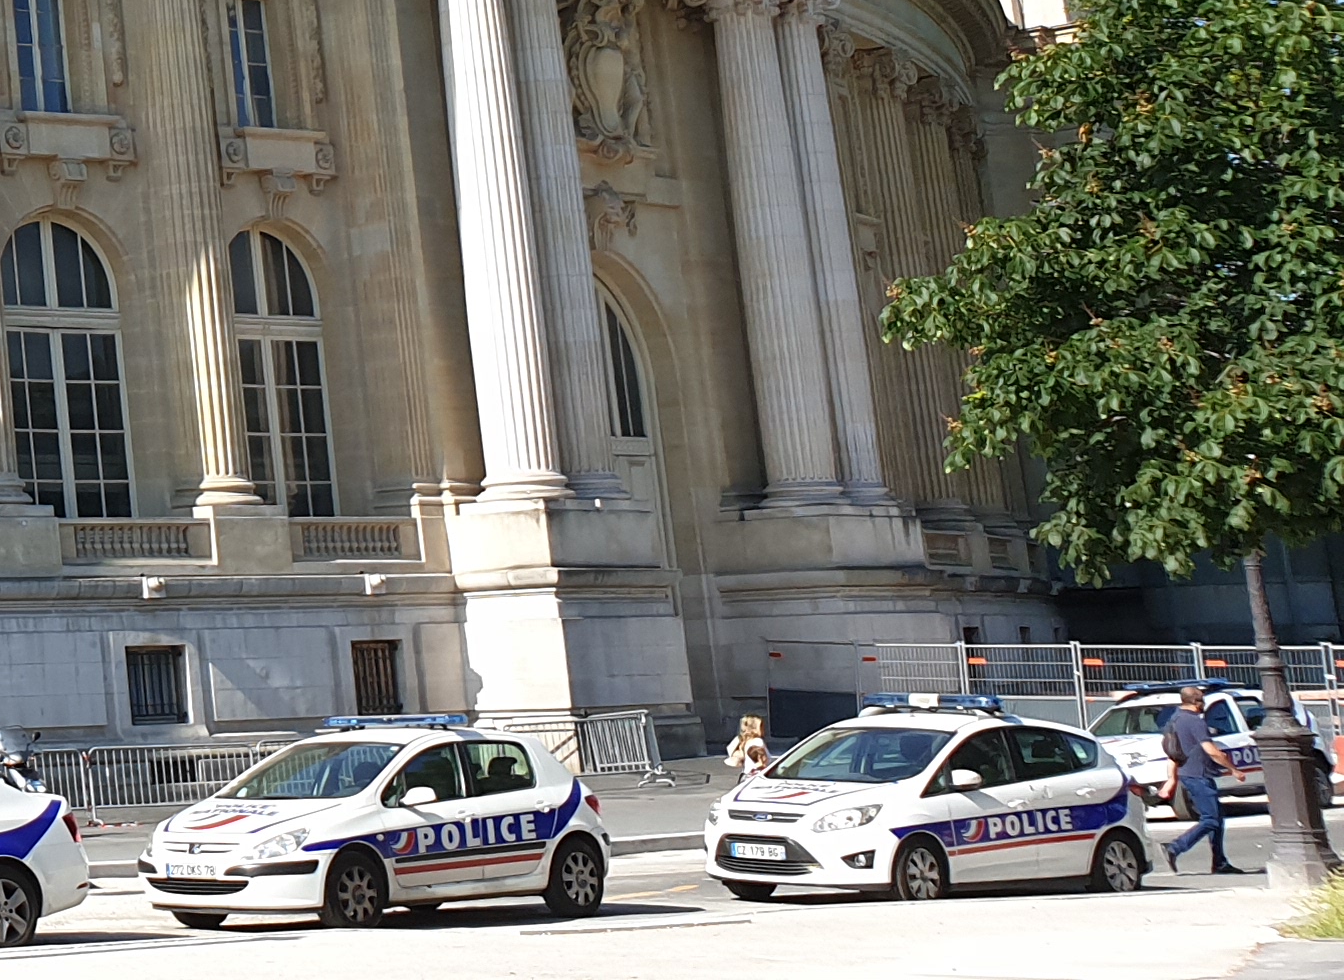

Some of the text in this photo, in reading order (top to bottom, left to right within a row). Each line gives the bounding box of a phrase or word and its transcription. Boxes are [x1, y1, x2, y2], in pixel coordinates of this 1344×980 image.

[1232, 747, 1261, 765] POL
[416, 813, 538, 854] POLICE
[987, 808, 1074, 839] POLICE
